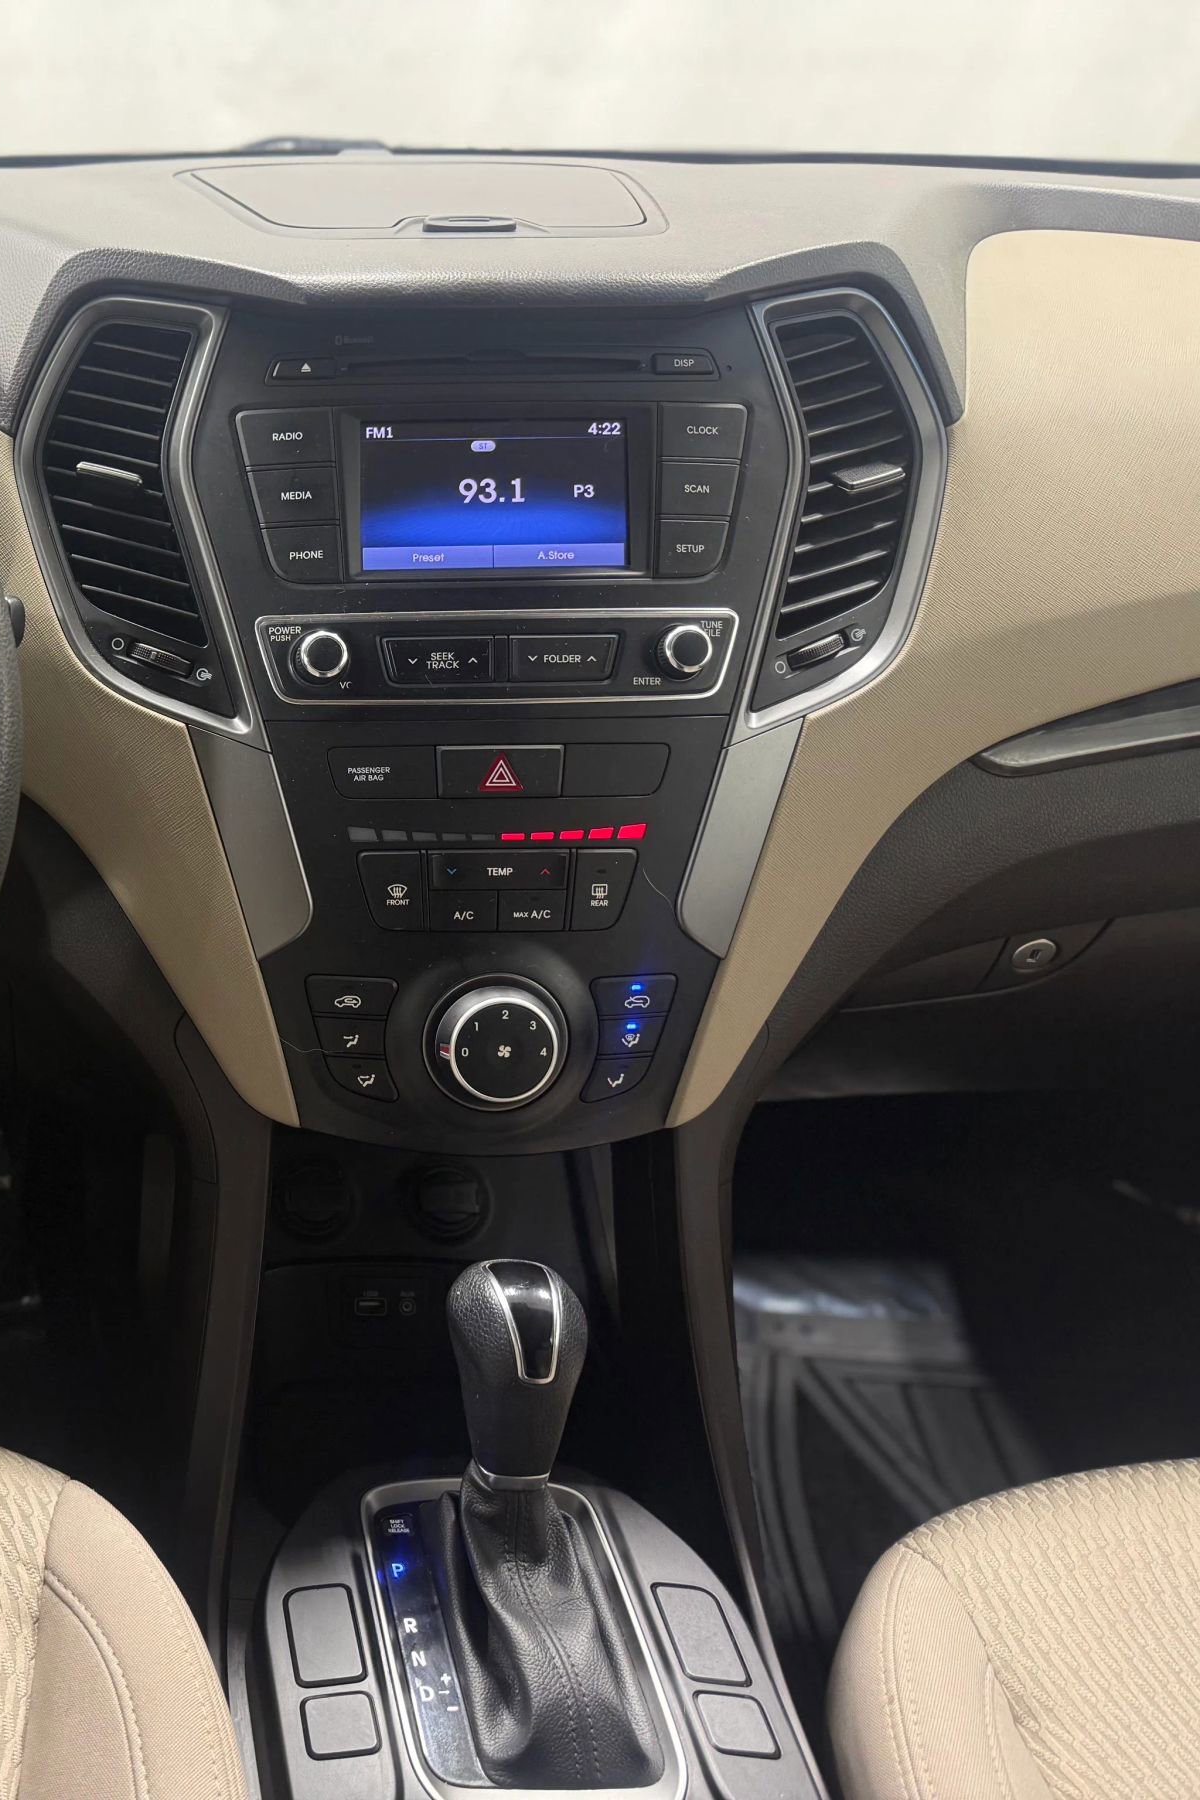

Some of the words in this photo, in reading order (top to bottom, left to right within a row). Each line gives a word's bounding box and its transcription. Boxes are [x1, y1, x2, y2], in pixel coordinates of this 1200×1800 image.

[673, 358, 695, 368] DISP
[365, 426, 394, 439] FM1
[588, 422, 621, 436] 4:22
[686, 425, 719, 435] CLOCK
[272, 432, 303, 442] RADIO
[478, 441, 488, 450] ST
[458, 478, 525, 504] 93.1
[573, 484, 595, 499] P3
[684, 484, 710, 494] SCAN
[281, 490, 312, 501] MEDIA
[676, 543, 705, 554] SETUP
[289, 550, 323, 561] PHONE
[412, 551, 445, 563] Preset
[537, 549, 575, 561] A.Store
[701, 620, 724, 630] TUNE
[268, 625, 302, 636] POWER
[704, 628, 722, 638] FILE
[270, 634, 291, 642] PUSH
[430, 652, 455, 662] SEEK
[543, 653, 581, 664] FOLDER
[426, 661, 460, 670] TRACK
[632, 677, 661, 686] ENTER
[347, 766, 391, 776] PASSENGER
[353, 774, 367, 782] AIR
[368, 774, 384, 783] BAG
[487, 867, 514, 877] TEMP
[386, 898, 410, 907] FRONT
[590, 899, 609, 908] REAR
[453, 910, 475, 921] A/C
[513, 911, 529, 919] MAX
[531, 909, 552, 920] A/C
[502, 1010, 509, 1020] 2
[474, 1022, 480, 1031] 1
[530, 1021, 537, 1031] 3
[461, 1047, 469, 1057] 0
[540, 1047, 548, 1057] 4
[391, 1563, 404, 1578] P
[403, 1617, 418, 1634] R
[411, 1651, 427, 1667] N
[419, 1686, 435, 1702] D
